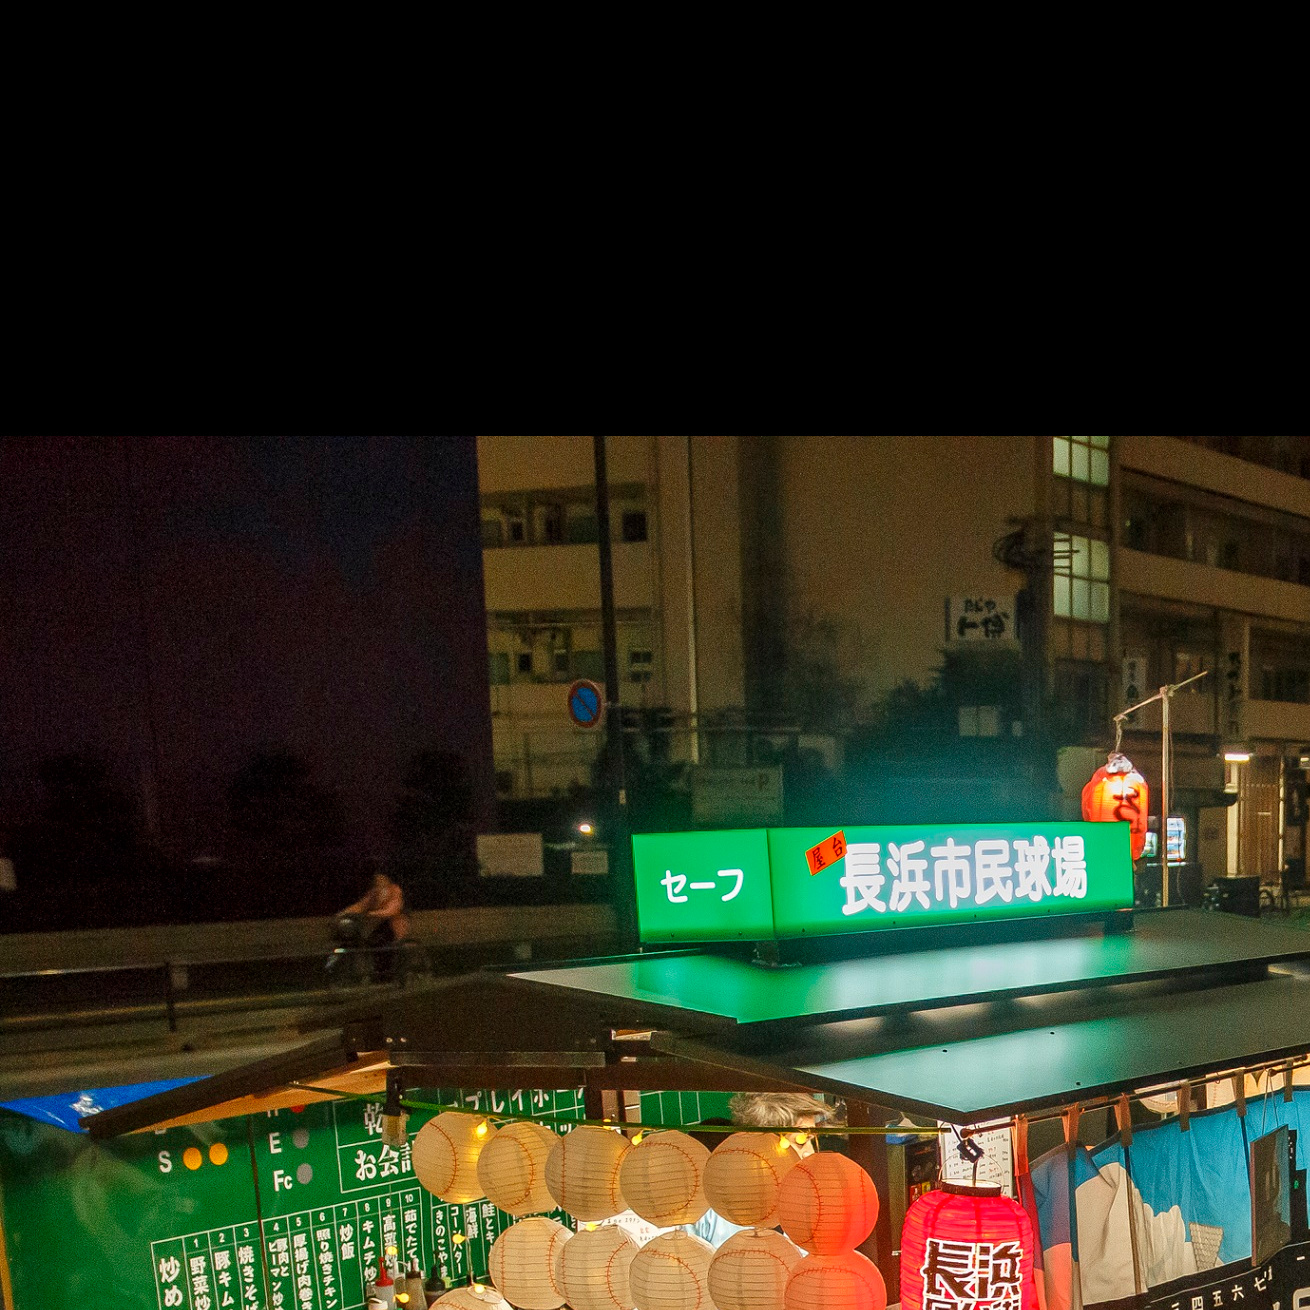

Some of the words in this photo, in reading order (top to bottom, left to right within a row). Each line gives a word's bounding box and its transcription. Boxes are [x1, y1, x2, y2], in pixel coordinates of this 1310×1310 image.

[811, 835, 844, 869] 屋台
[660, 868, 744, 903] セーフ
[840, 835, 1088, 916] 長浜市民球場
[268, 1132, 282, 1154] E
[158, 1150, 172, 1173] S
[354, 1143, 412, 1181] お会計
[273, 1169, 293, 1192] Fc
[364, 1203, 371, 1212] 8
[386, 1198, 392, 1207] 9
[405, 1194, 414, 1202] 10
[296, 1217, 302, 1227] 5
[319, 1212, 326, 1222] 6
[342, 1207, 348, 1217] 7
[465, 1207, 479, 1239] 海鮮
[243, 1227, 250, 1238] 3
[273, 1222, 280, 1232] 4
[482, 1203, 496, 1247] 鮭とキ
[193, 1238, 199, 1248] 1
[218, 1232, 225, 1243] 2
[339, 1223, 355, 1260] 炒飯
[362, 1220, 378, 1285] キムチ炒
[316, 1228, 338, 1309] 照り焼きチキン
[920, 1238, 1023, 1300] 長浜
